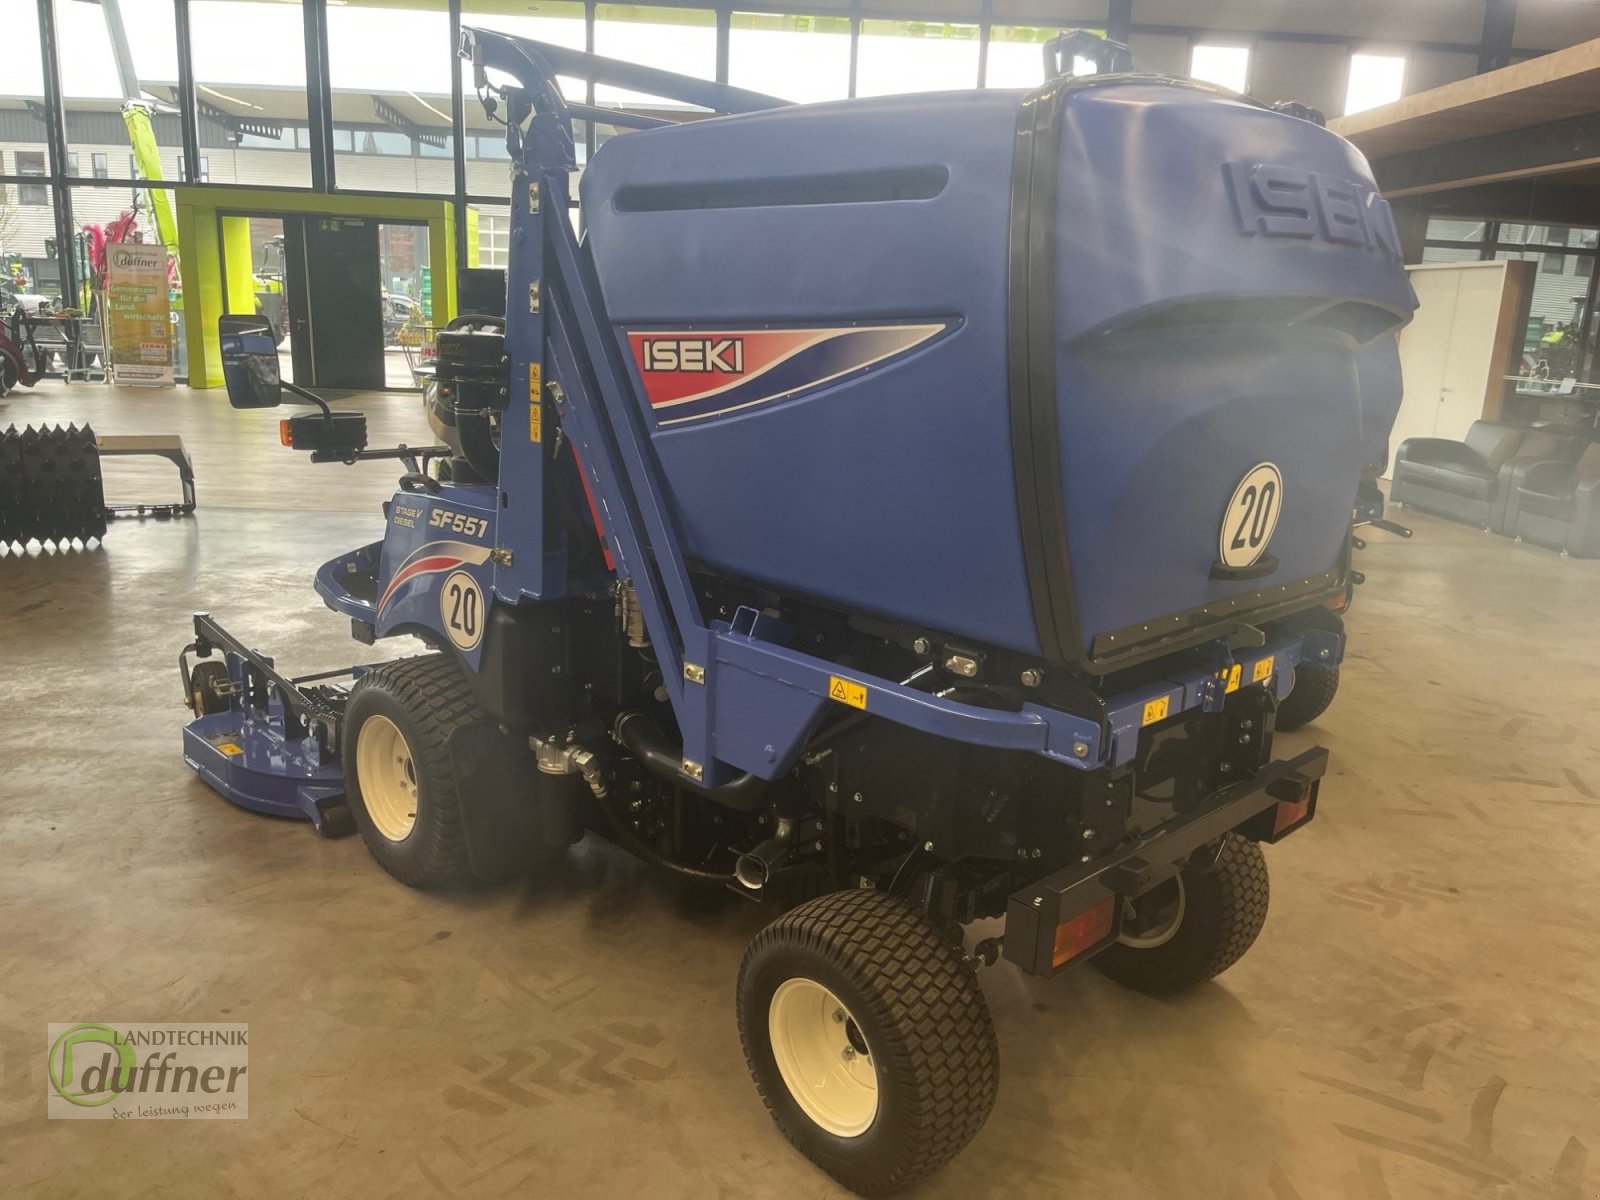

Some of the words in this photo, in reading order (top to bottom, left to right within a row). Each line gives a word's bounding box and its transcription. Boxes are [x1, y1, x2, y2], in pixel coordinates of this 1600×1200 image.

[643, 338, 744, 374] ISEKI
[393, 516, 415, 529] DIESEL
[429, 508, 488, 538] SF551
[1230, 480, 1276, 551] 20
[450, 583, 476, 637] 20
